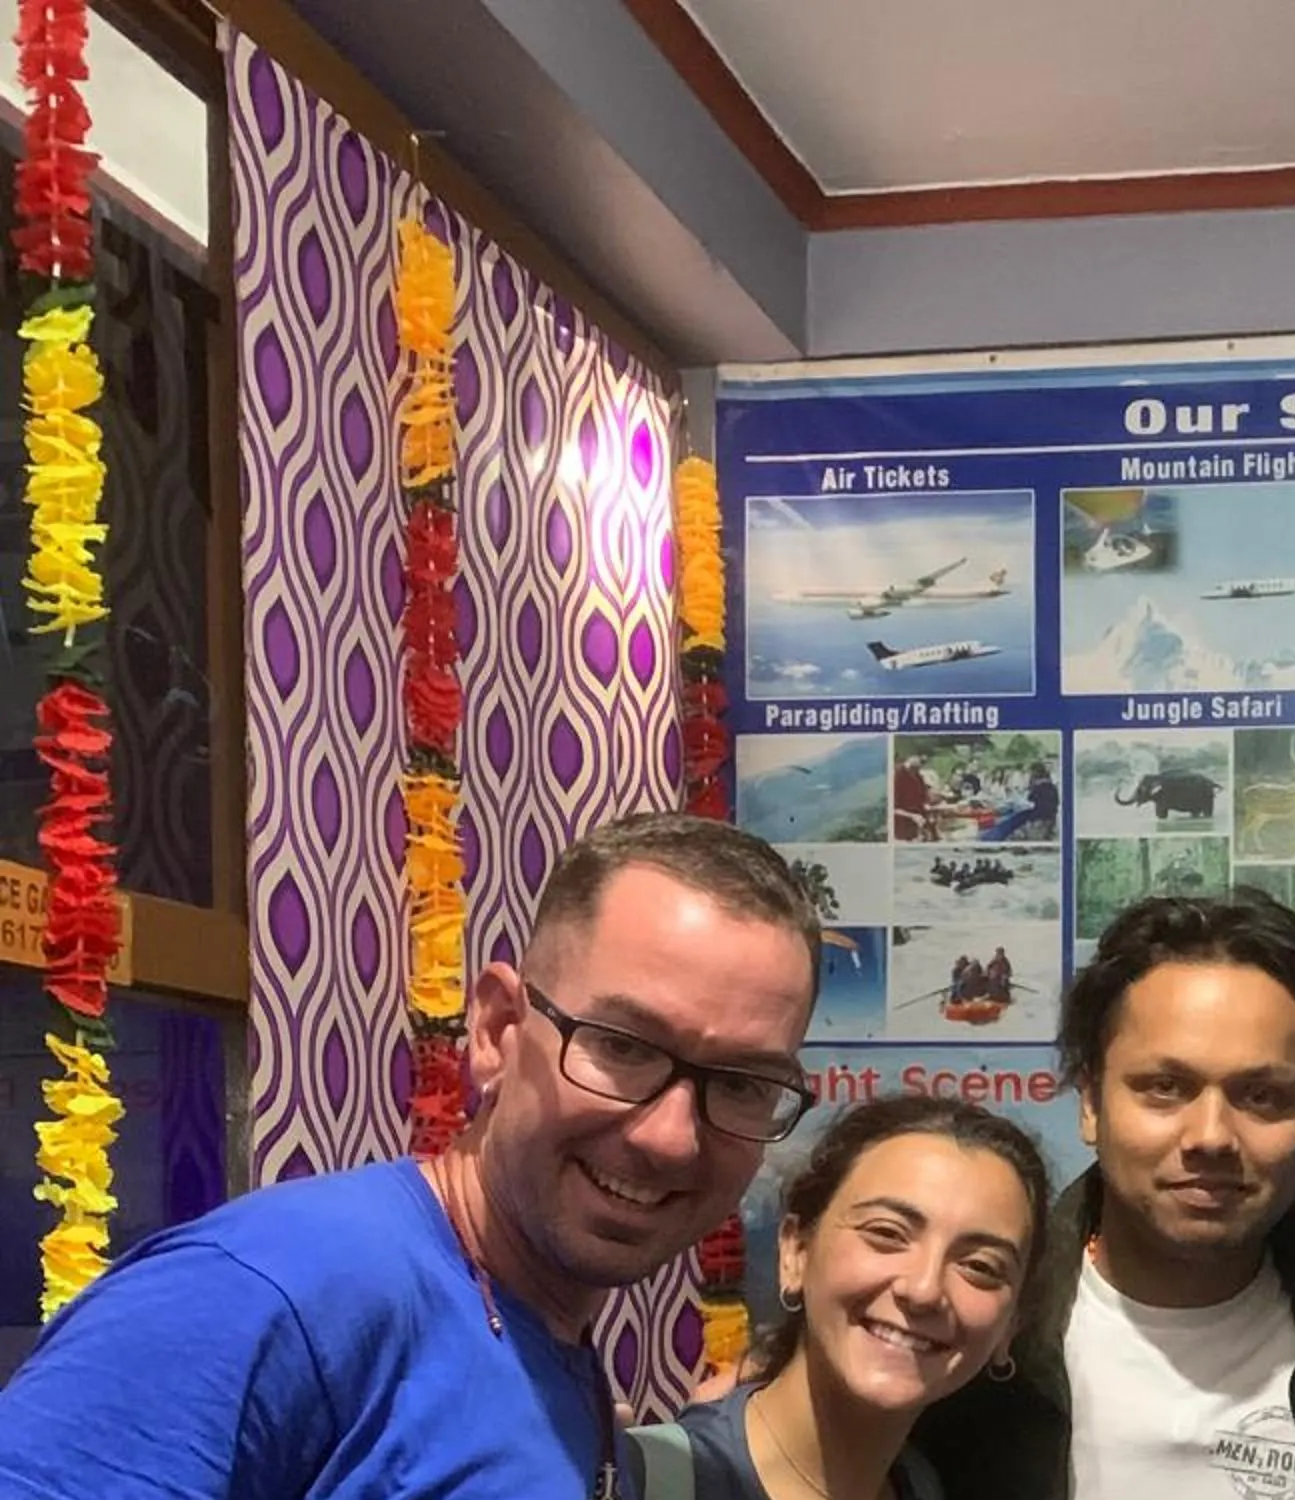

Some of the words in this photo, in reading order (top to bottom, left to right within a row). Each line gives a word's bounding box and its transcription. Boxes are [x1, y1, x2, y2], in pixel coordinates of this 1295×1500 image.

[1123, 397, 1250, 436] Our
[821, 466, 857, 491] Air
[863, 464, 951, 490] Tickets
[1121, 455, 1235, 481] Mountain
[765, 700, 1000, 730] Paragliding/Rafting
[1121, 699, 1204, 722] Jungle
[1212, 694, 1283, 720] Safari
[0, 875, 21, 910] CE
